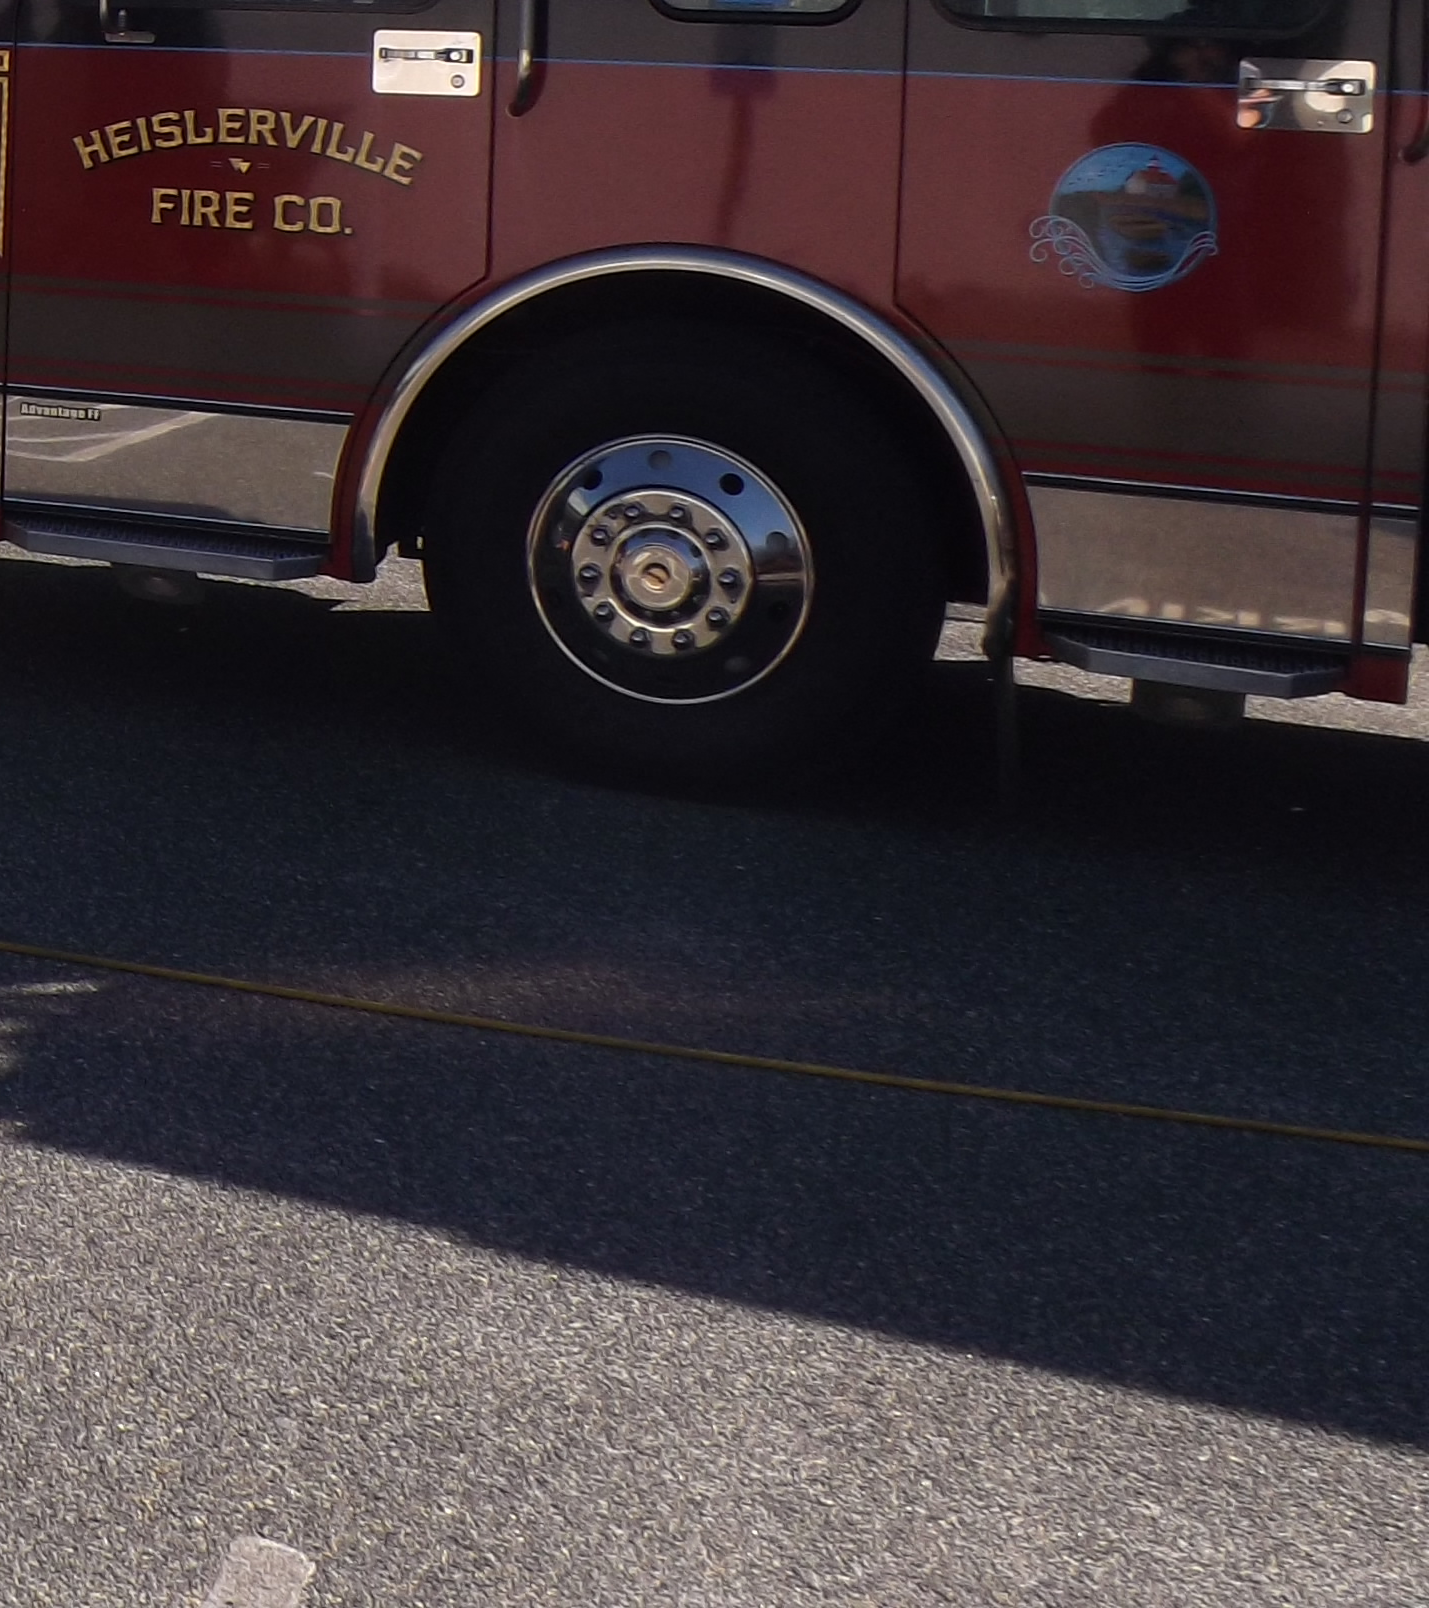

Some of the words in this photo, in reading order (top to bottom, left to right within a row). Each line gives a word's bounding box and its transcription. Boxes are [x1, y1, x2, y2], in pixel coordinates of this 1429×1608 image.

[72, 107, 423, 186] HEISLERVILLE
[150, 187, 255, 230] FIRE
[272, 193, 354, 235] CO.
[21, 402, 86, 419] Advantage
